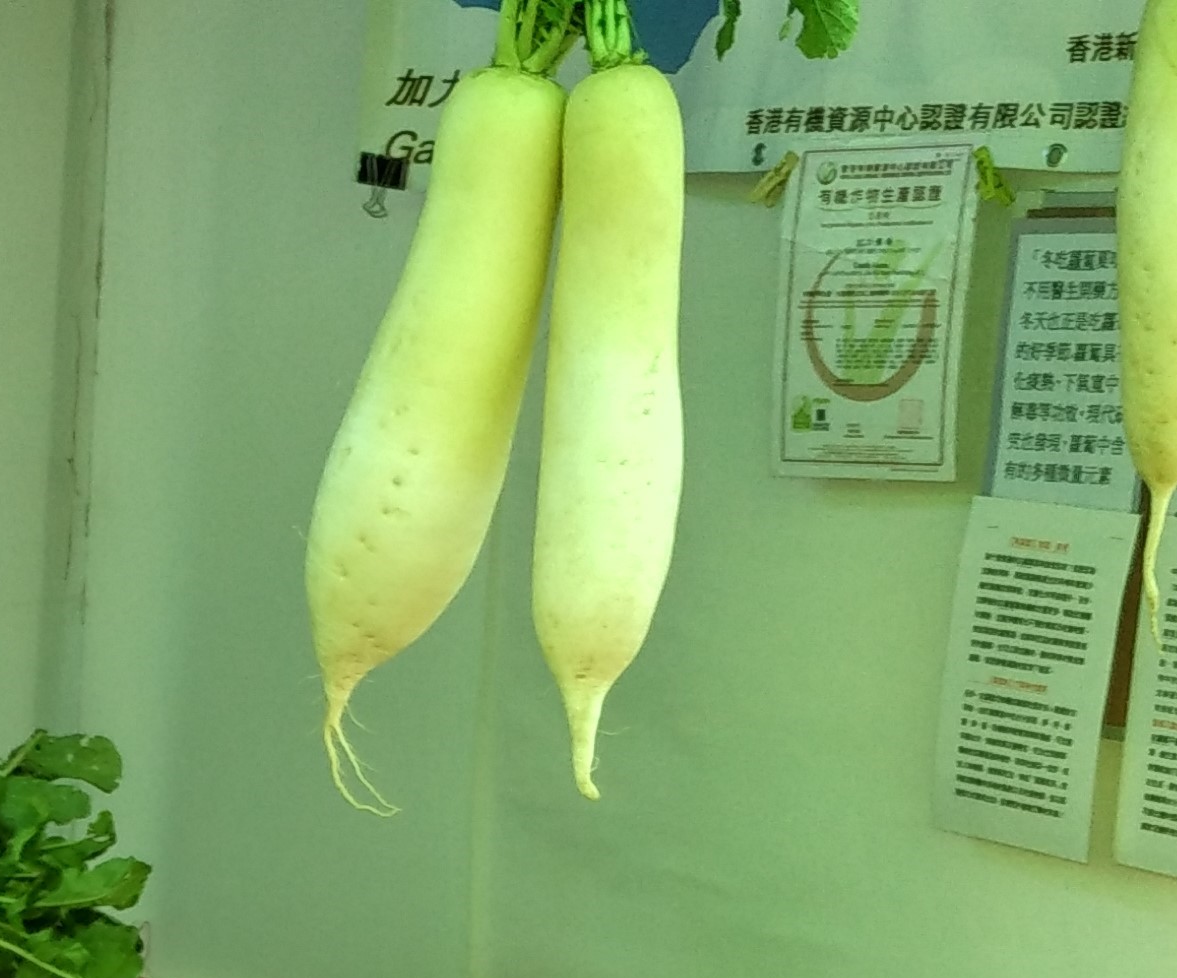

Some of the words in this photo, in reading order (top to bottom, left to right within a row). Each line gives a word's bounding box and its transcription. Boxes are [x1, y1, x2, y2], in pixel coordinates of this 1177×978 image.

[745, 101, 1129, 135] 香港有機資源中心認證有限公司認證
